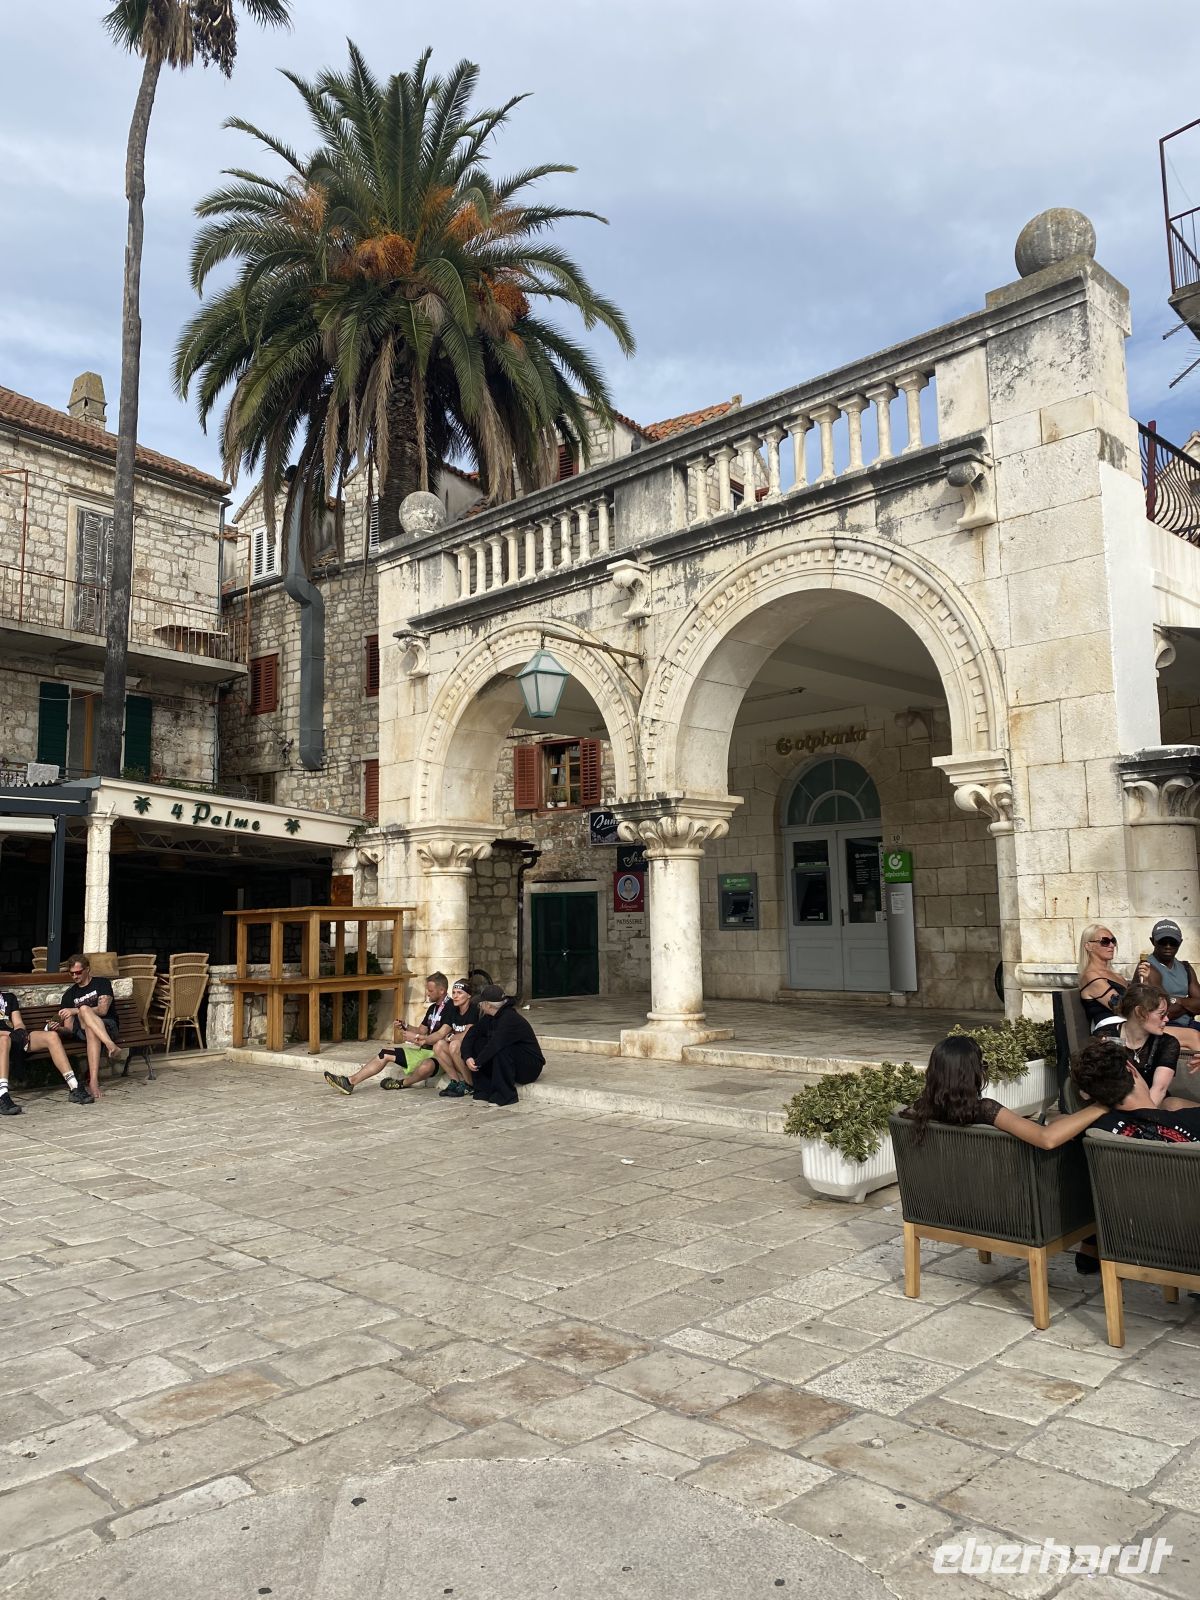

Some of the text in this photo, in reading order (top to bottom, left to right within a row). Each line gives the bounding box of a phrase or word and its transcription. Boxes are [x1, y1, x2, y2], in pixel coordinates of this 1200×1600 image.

[171, 803, 261, 831] 4 Palme
[593, 814, 619, 829] Jun
